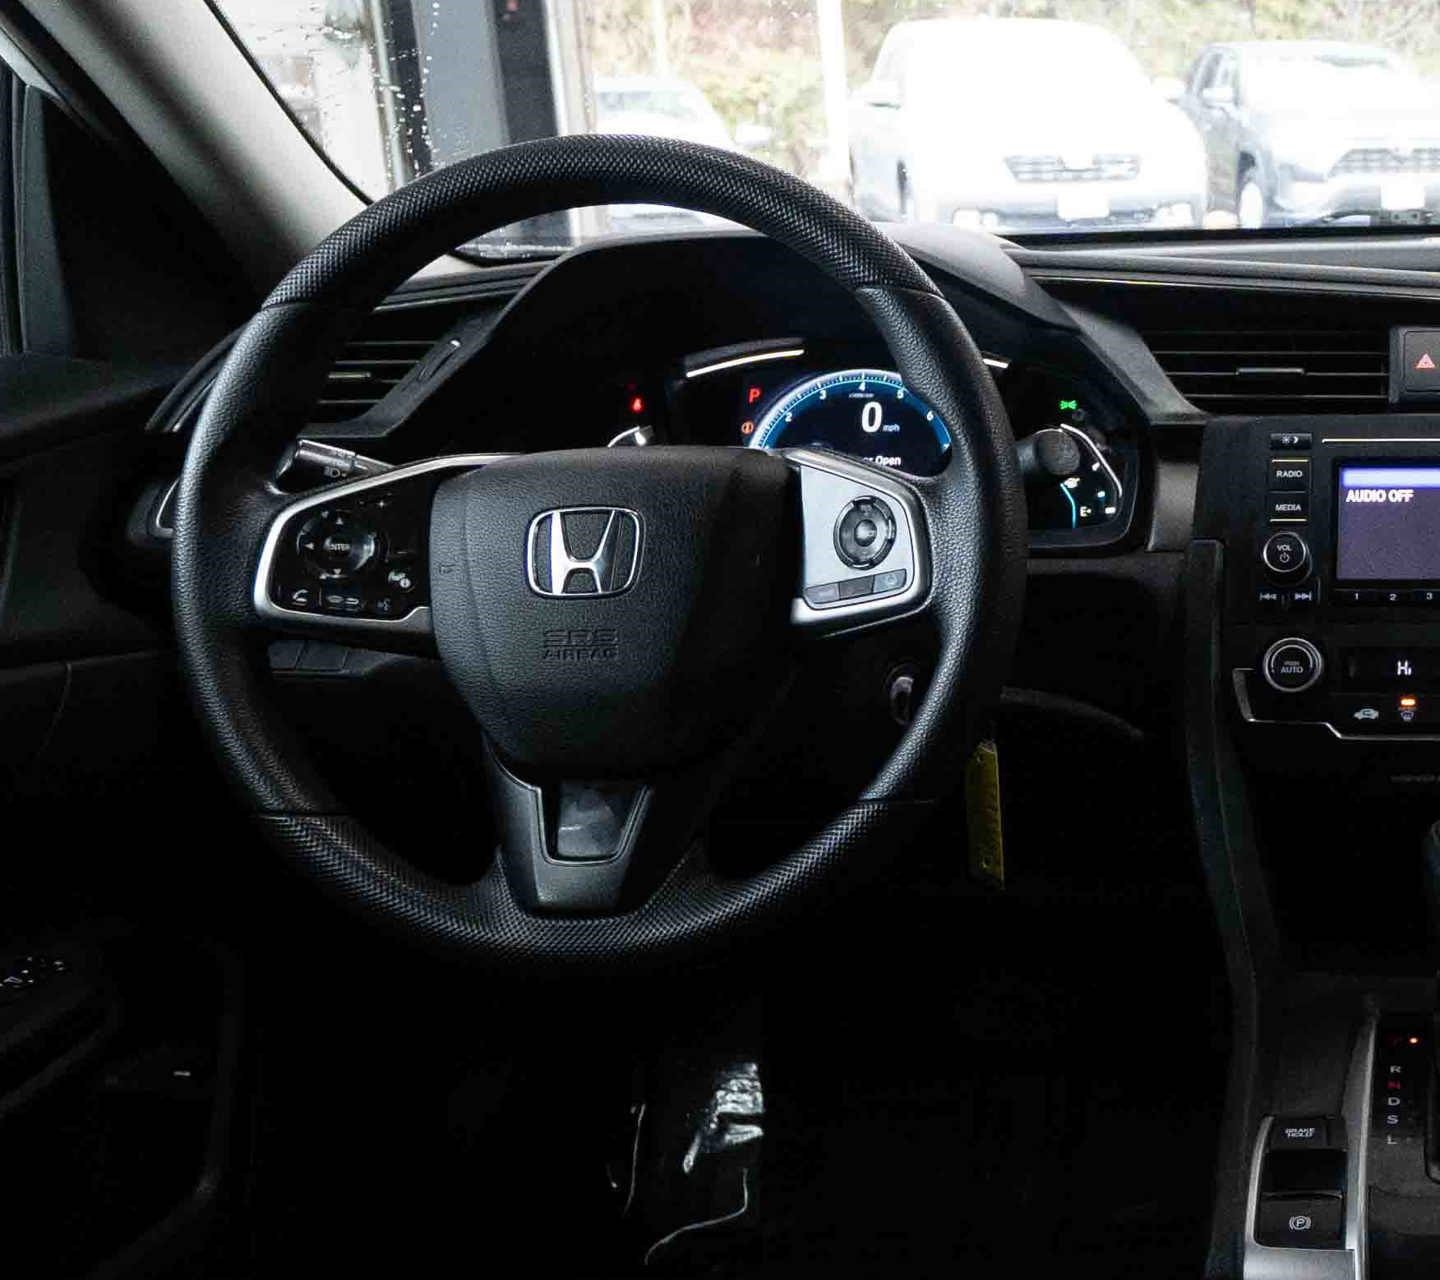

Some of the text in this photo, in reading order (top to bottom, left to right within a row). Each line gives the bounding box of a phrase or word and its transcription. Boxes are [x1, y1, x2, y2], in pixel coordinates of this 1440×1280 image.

[748, 387, 760, 403] P
[819, 390, 827, 400] 3
[785, 413, 793, 423] 2
[862, 401, 900, 433] 0 mph
[926, 410, 934, 421] 6
[1276, 470, 1303, 479] RADIO
[1345, 489, 1415, 503] AUDIO OFF
[1275, 503, 1302, 512] MEDIA
[1276, 544, 1293, 552] VOL
[1353, 592, 1360, 600] 1
[1389, 593, 1398, 601] 2
[1426, 592, 1433, 601] 3
[1280, 666, 1304, 674] AUTO
[1387, 1097, 1400, 1106] D
[1386, 1114, 1399, 1125] S
